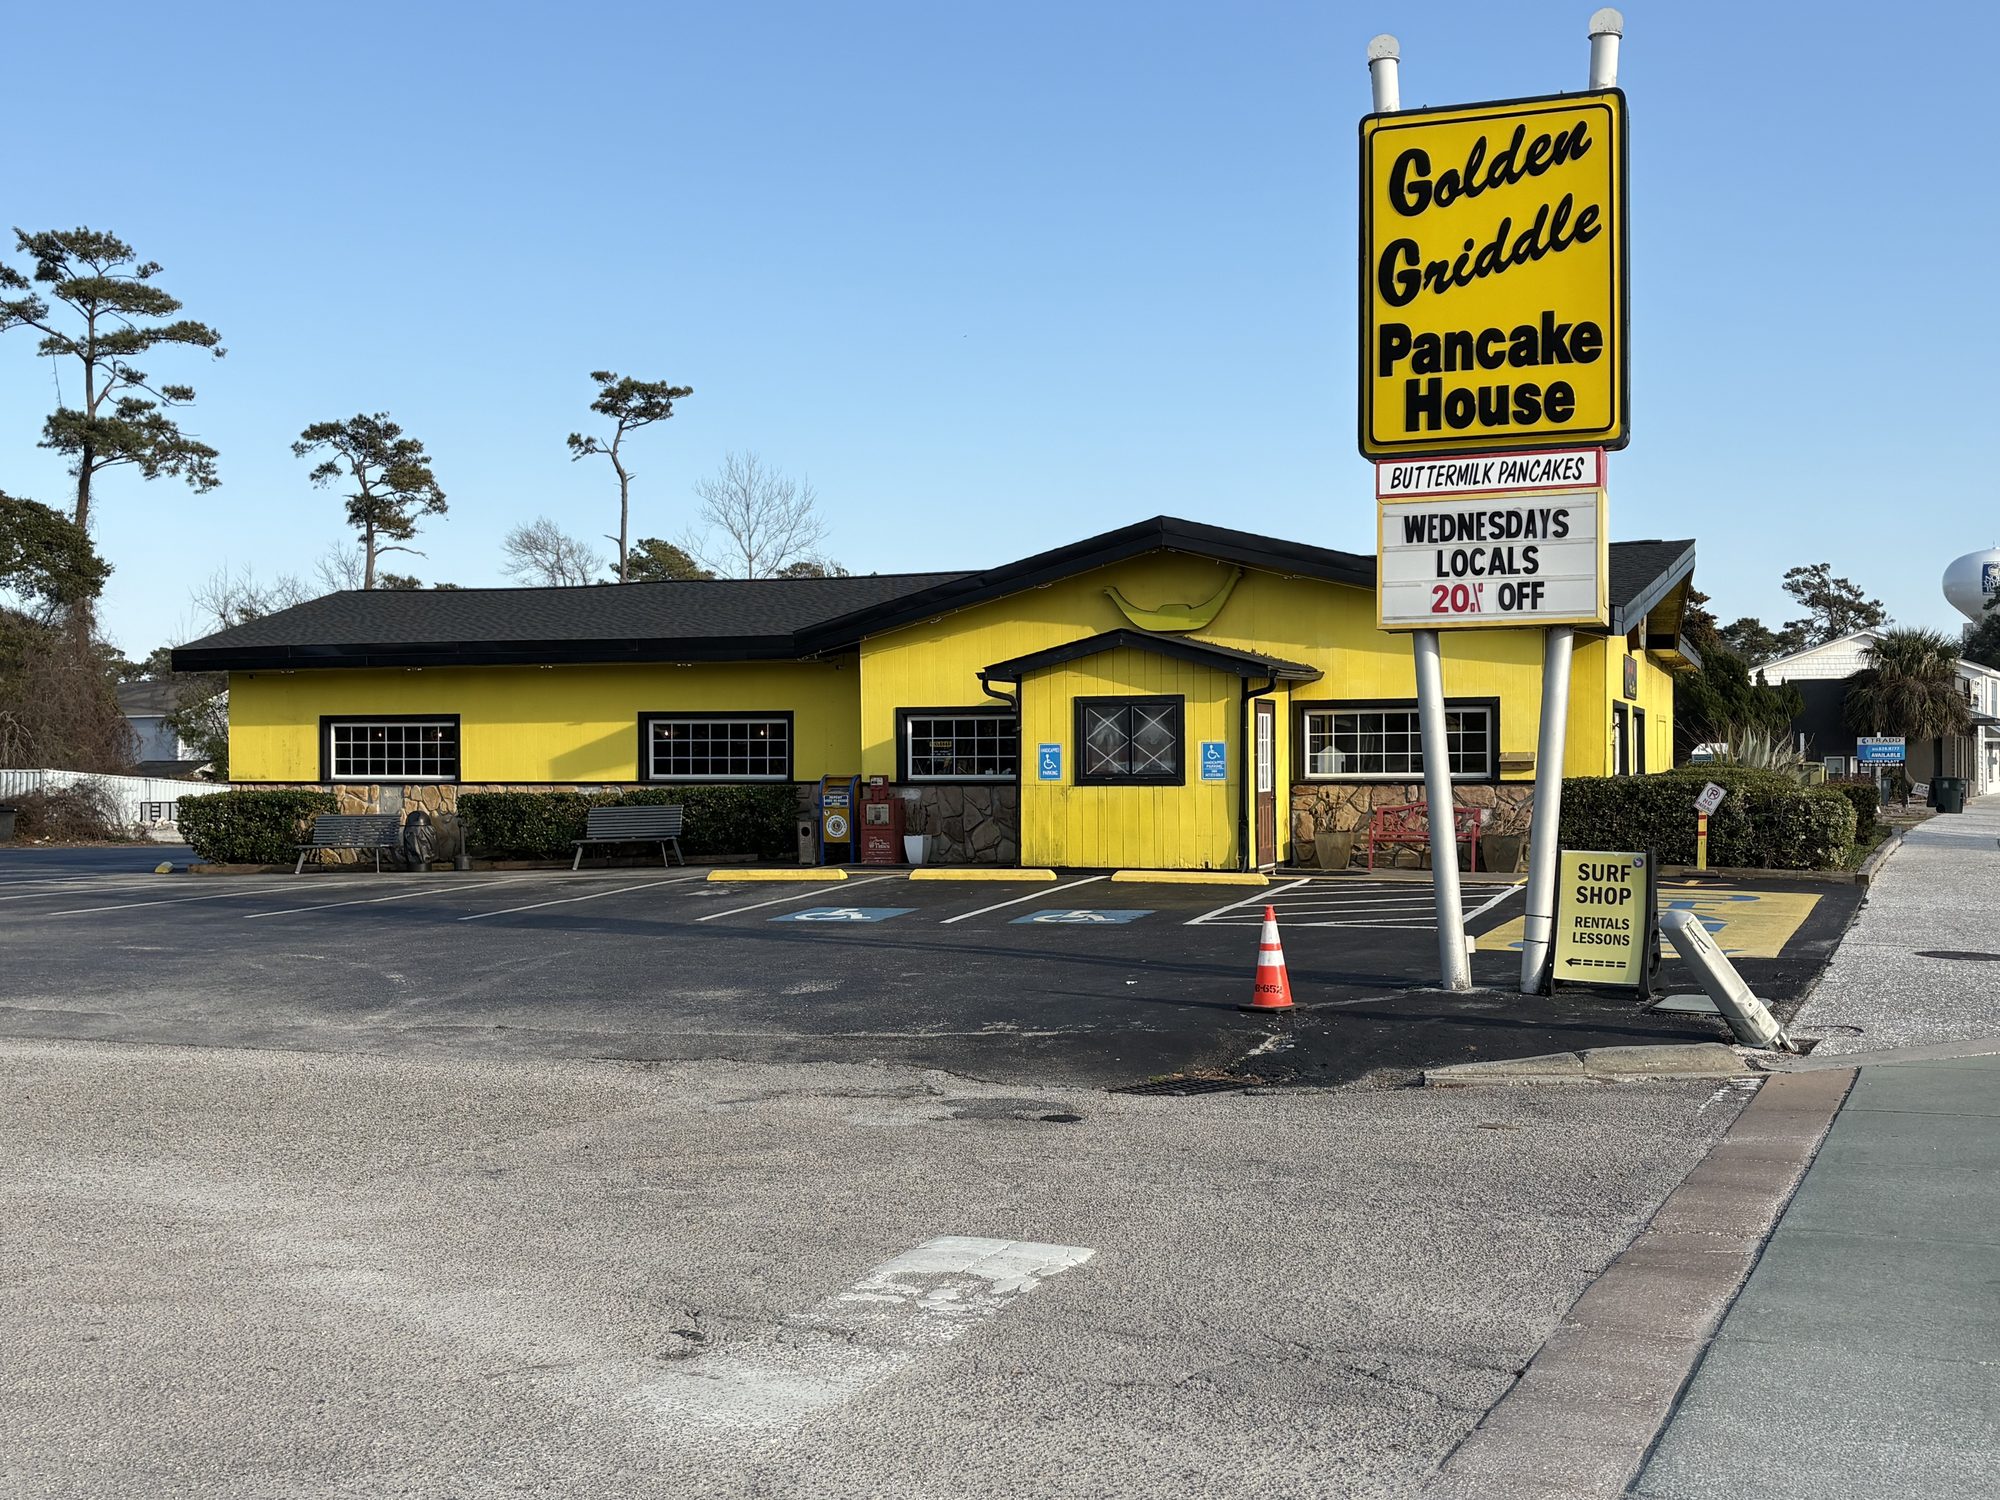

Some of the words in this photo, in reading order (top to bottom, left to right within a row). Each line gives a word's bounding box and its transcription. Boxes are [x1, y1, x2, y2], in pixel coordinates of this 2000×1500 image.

[1388, 120, 1593, 217] Golden
[1377, 192, 1603, 308] Griddle
[1378, 310, 1604, 377] Pancake
[1405, 378, 1576, 432] House
[1390, 461, 1495, 489] BUTTERMILK
[1497, 456, 1585, 484] PANCAKES
[1404, 508, 1570, 544] WEDNESDAYS
[1436, 546, 1539, 578] LOCALS
[1498, 581, 1545, 611] OFF
[1703, 798, 1713, 806] NO
[1578, 863, 1632, 882] SURF
[1576, 886, 1631, 905] SHOP
[1572, 932, 1630, 946] LESSONS
[1574, 916, 1630, 930] RENTALS
